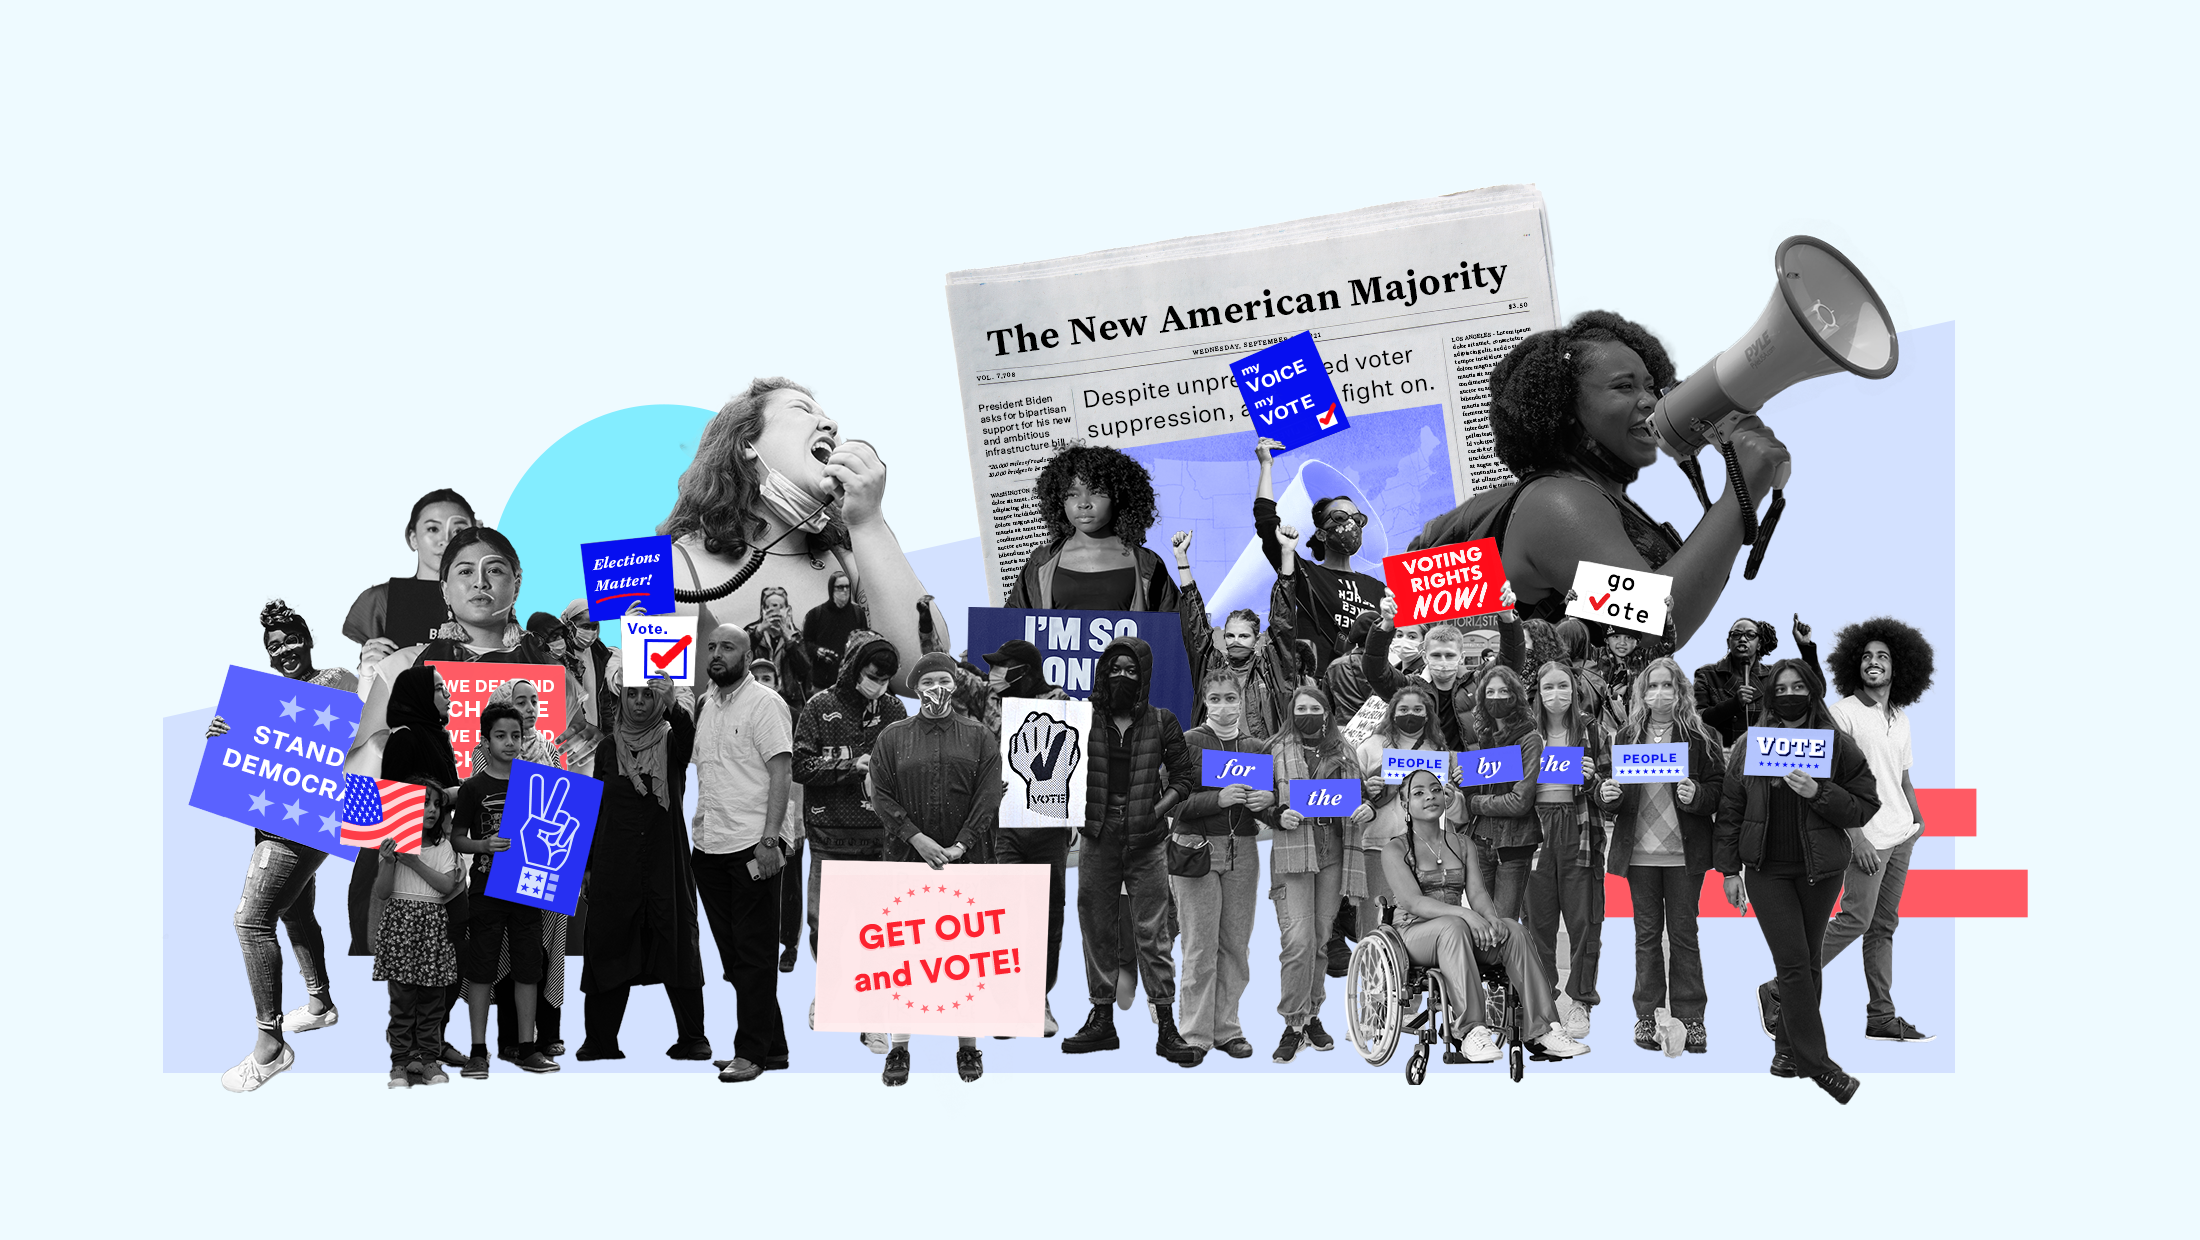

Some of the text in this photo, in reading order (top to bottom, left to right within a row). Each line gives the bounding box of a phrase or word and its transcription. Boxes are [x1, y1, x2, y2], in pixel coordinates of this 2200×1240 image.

[987, 261, 1508, 357] The New American Majority
[1508, 301, 1529, 310] $3.50
[1192, 343, 1242, 356] WEDNESDAY,
[1744, 329, 1771, 362] PYLE
[1241, 363, 1260, 376] my
[1245, 359, 1307, 392] VOICE
[1083, 382, 1170, 409] Despite
[1355, 350, 1413, 370] voter
[978, 395, 1052, 412] President Biden
[1088, 405, 1234, 438] suppression,
[1342, 380, 1394, 404] fight
[1401, 378, 1435, 394] on.
[1254, 395, 1274, 409] my
[1259, 394, 1315, 425] VOTE
[980, 405, 1066, 423] asks for bipartisan
[982, 416, 1071, 435] support for his new
[983, 430, 1050, 445] and ambitious
[985, 438, 1068, 457] infrastructure bill.
[592, 553, 660, 571] Elections
[1401, 546, 1482, 575] VOTING
[594, 574, 652, 592] Matter!
[1410, 565, 1482, 592] RIGHTS
[1607, 574, 1634, 592] go
[1413, 581, 1487, 620] NOW!
[627, 622, 667, 634] Vote.
[1024, 615, 1081, 651] I'M
[443, 680, 554, 692] WE DEND
[253, 725, 345, 767] STAND
[1756, 736, 1826, 760] VOTE
[1388, 757, 1442, 769] PEOPLE
[1477, 756, 1501, 778] by
[1540, 754, 1571, 772] the
[1623, 753, 1677, 764] PEOPLE
[1216, 758, 1256, 779] for
[1031, 794, 1065, 804] VOTE
[1307, 788, 1343, 806] the
[859, 908, 1006, 950] GET OUT
[854, 947, 1021, 992] and VOTE!
